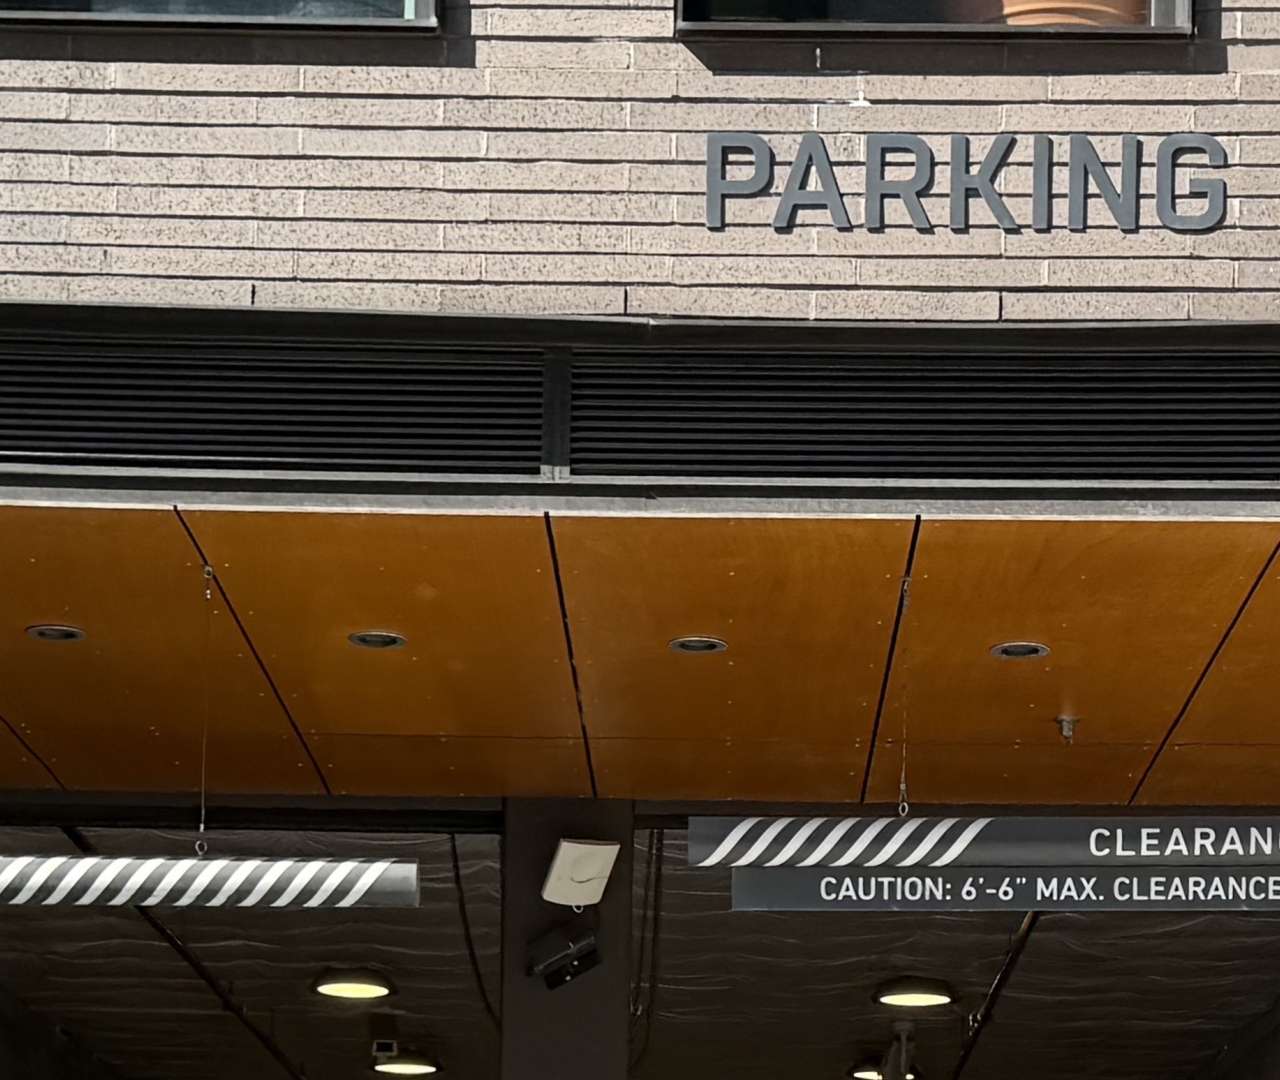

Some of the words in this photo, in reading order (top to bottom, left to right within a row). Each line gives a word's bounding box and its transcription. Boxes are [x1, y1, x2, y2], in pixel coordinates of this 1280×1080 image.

[705, 132, 1228, 232] PARKING
[819, 876, 952, 901] CAUTION:
[1035, 876, 1105, 901] MAX.
